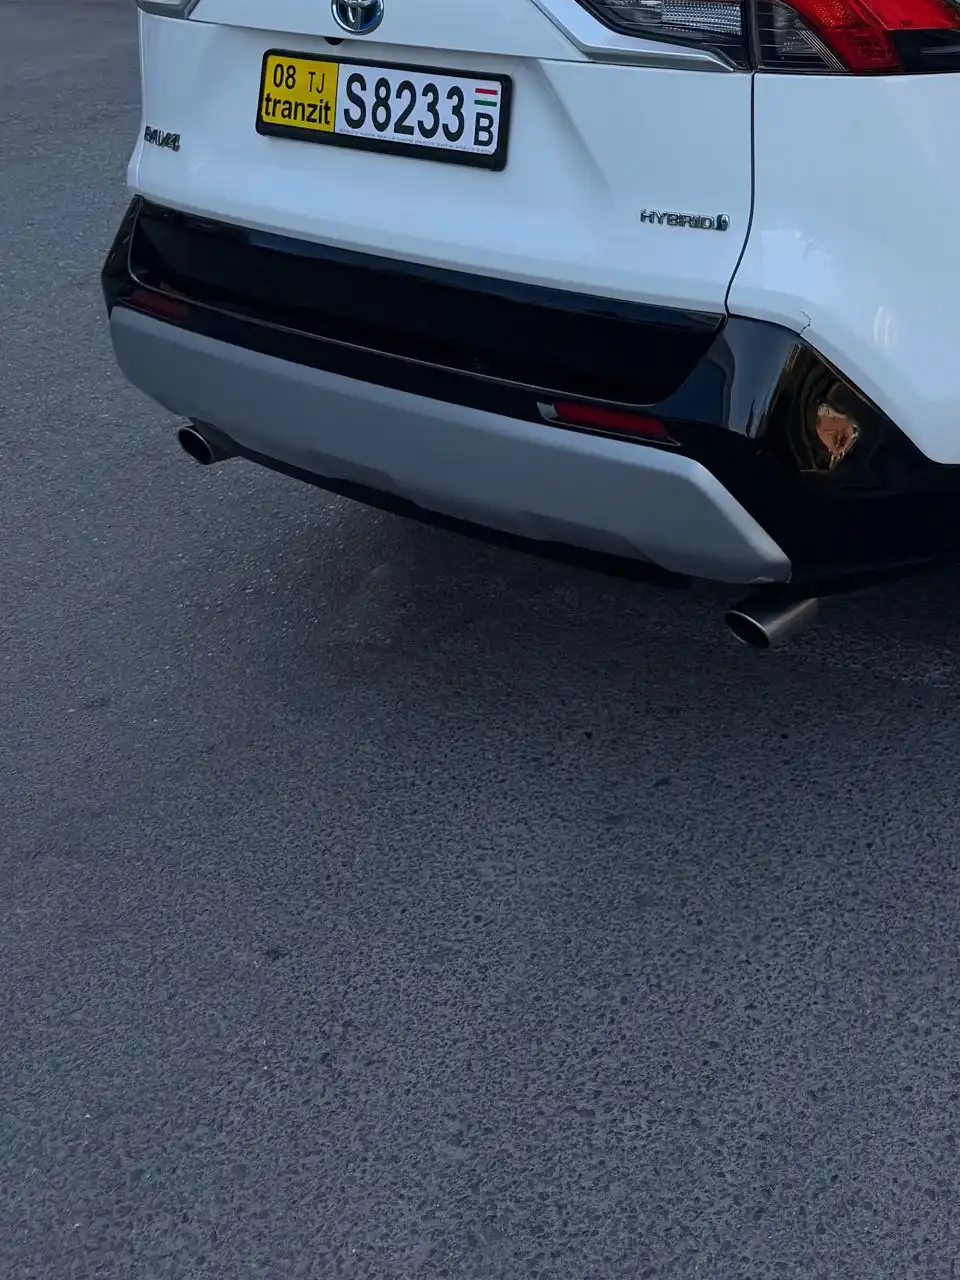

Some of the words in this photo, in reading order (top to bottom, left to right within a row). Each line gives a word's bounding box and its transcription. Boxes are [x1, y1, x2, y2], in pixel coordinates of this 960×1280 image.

[273, 63, 297, 90] 08
[308, 70, 326, 94] TJ
[264, 92, 331, 126] tranzit
[344, 73, 464, 142] S8233
[473, 111, 494, 147] B
[640, 208, 715, 231] HYBRID
